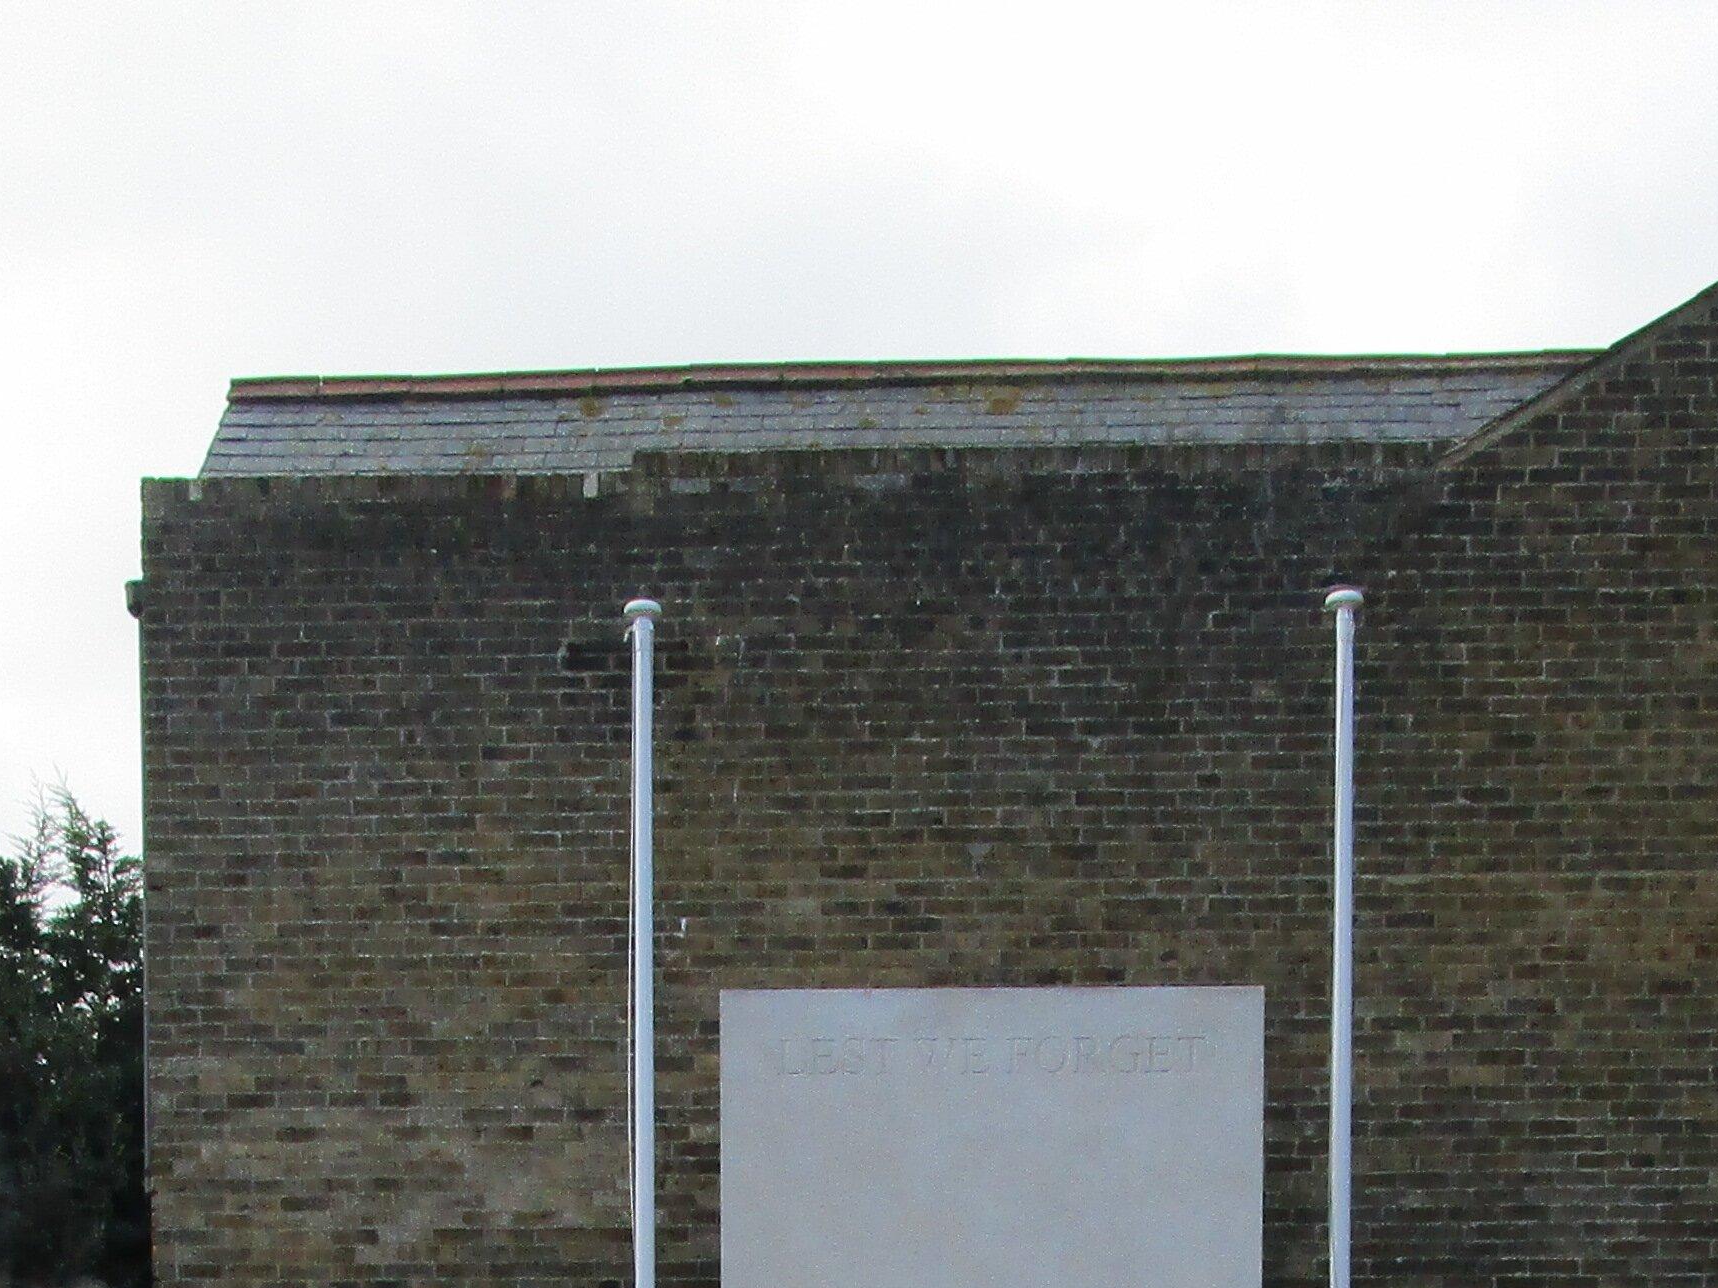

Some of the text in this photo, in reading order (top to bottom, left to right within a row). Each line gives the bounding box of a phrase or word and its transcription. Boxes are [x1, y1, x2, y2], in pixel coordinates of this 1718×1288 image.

[777, 1034, 1206, 1076] LEST WE FORGET
